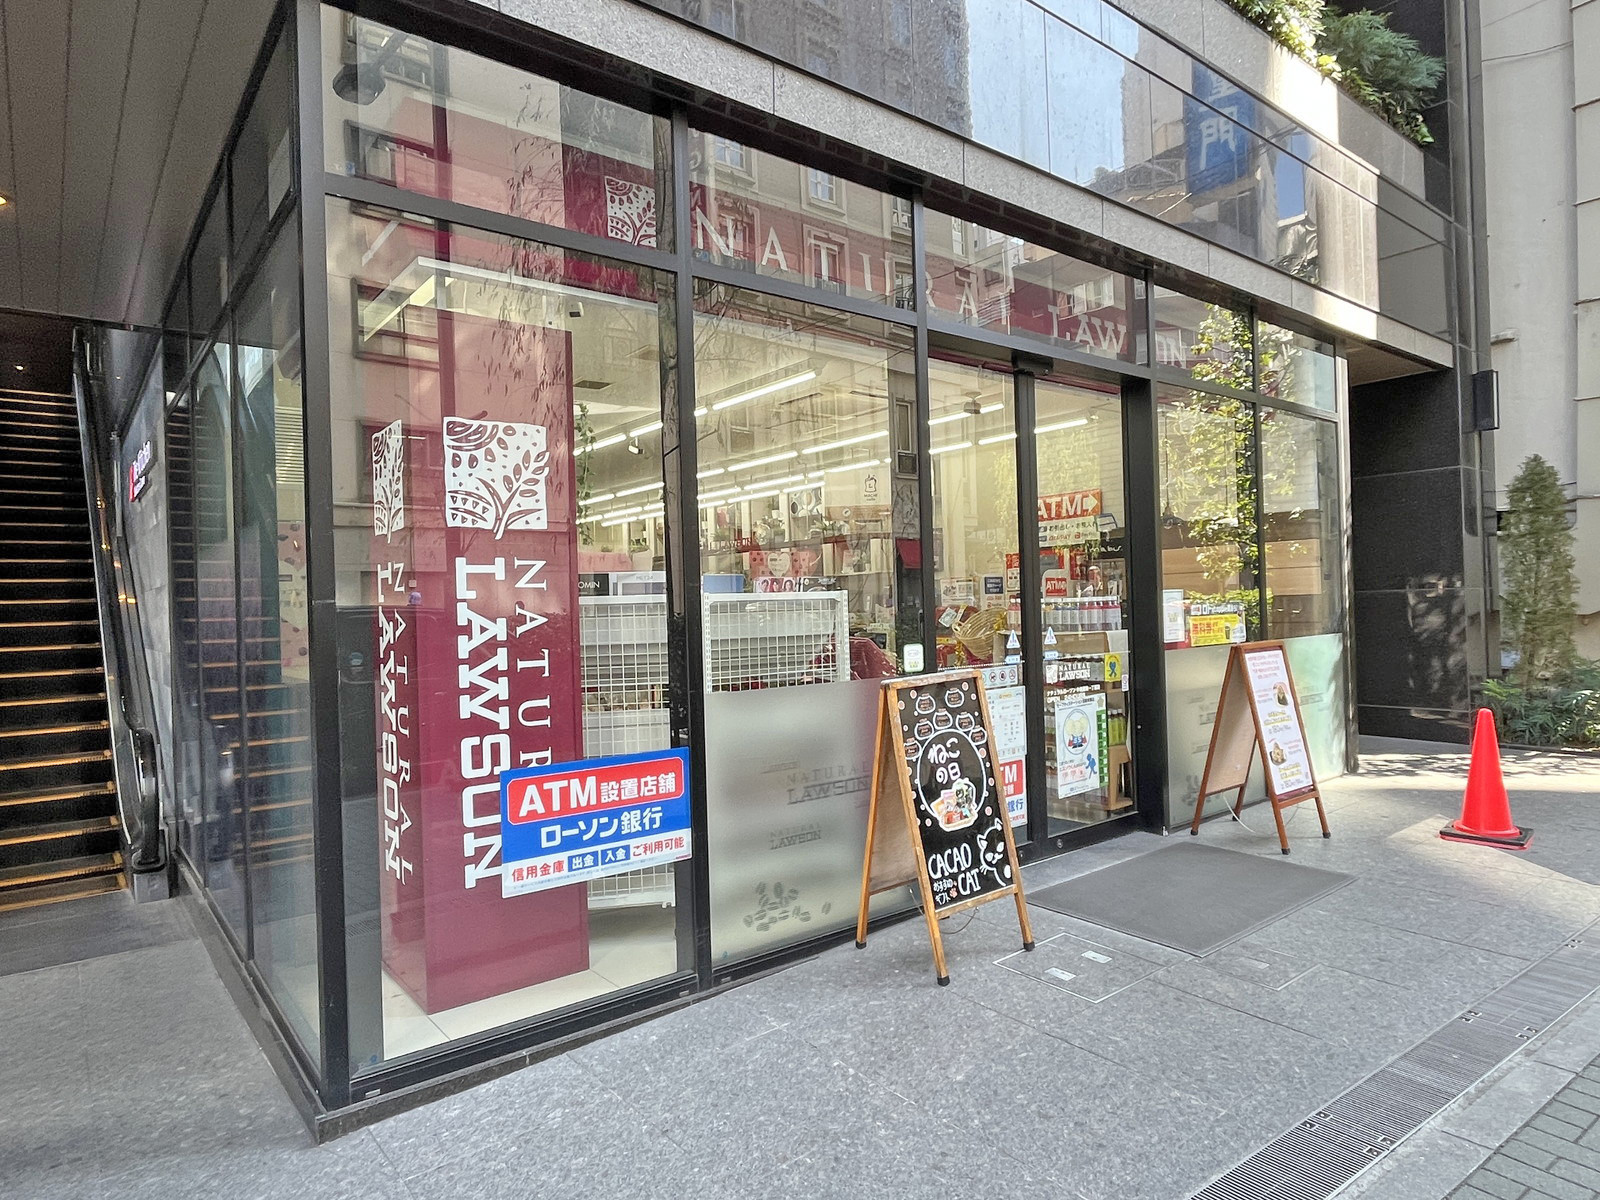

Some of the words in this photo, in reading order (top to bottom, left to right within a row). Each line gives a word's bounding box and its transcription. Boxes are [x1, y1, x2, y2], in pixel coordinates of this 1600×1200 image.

[1037, 494, 1083, 519] ATM
[1058, 661, 1091, 671] NATURAL
[1059, 669, 1091, 681] LAWSON
[377, 563, 402, 880] LAWSON
[393, 562, 414, 885] NATURAL
[455, 556, 512, 890] LAWSON
[927, 737, 961, 764] ねこ
[935, 762, 961, 785] の日
[518, 775, 598, 818] ATM
[600, 772, 677, 805] 設置店舗
[540, 806, 664, 849] ローソン銀行
[512, 859, 566, 883] 信用金庫
[571, 854, 595, 870] 出金
[604, 847, 627, 863] 入金
[632, 836, 685, 857] ご利用可能
[928, 842, 972, 879] CACAO
[958, 868, 981, 895] CAT
